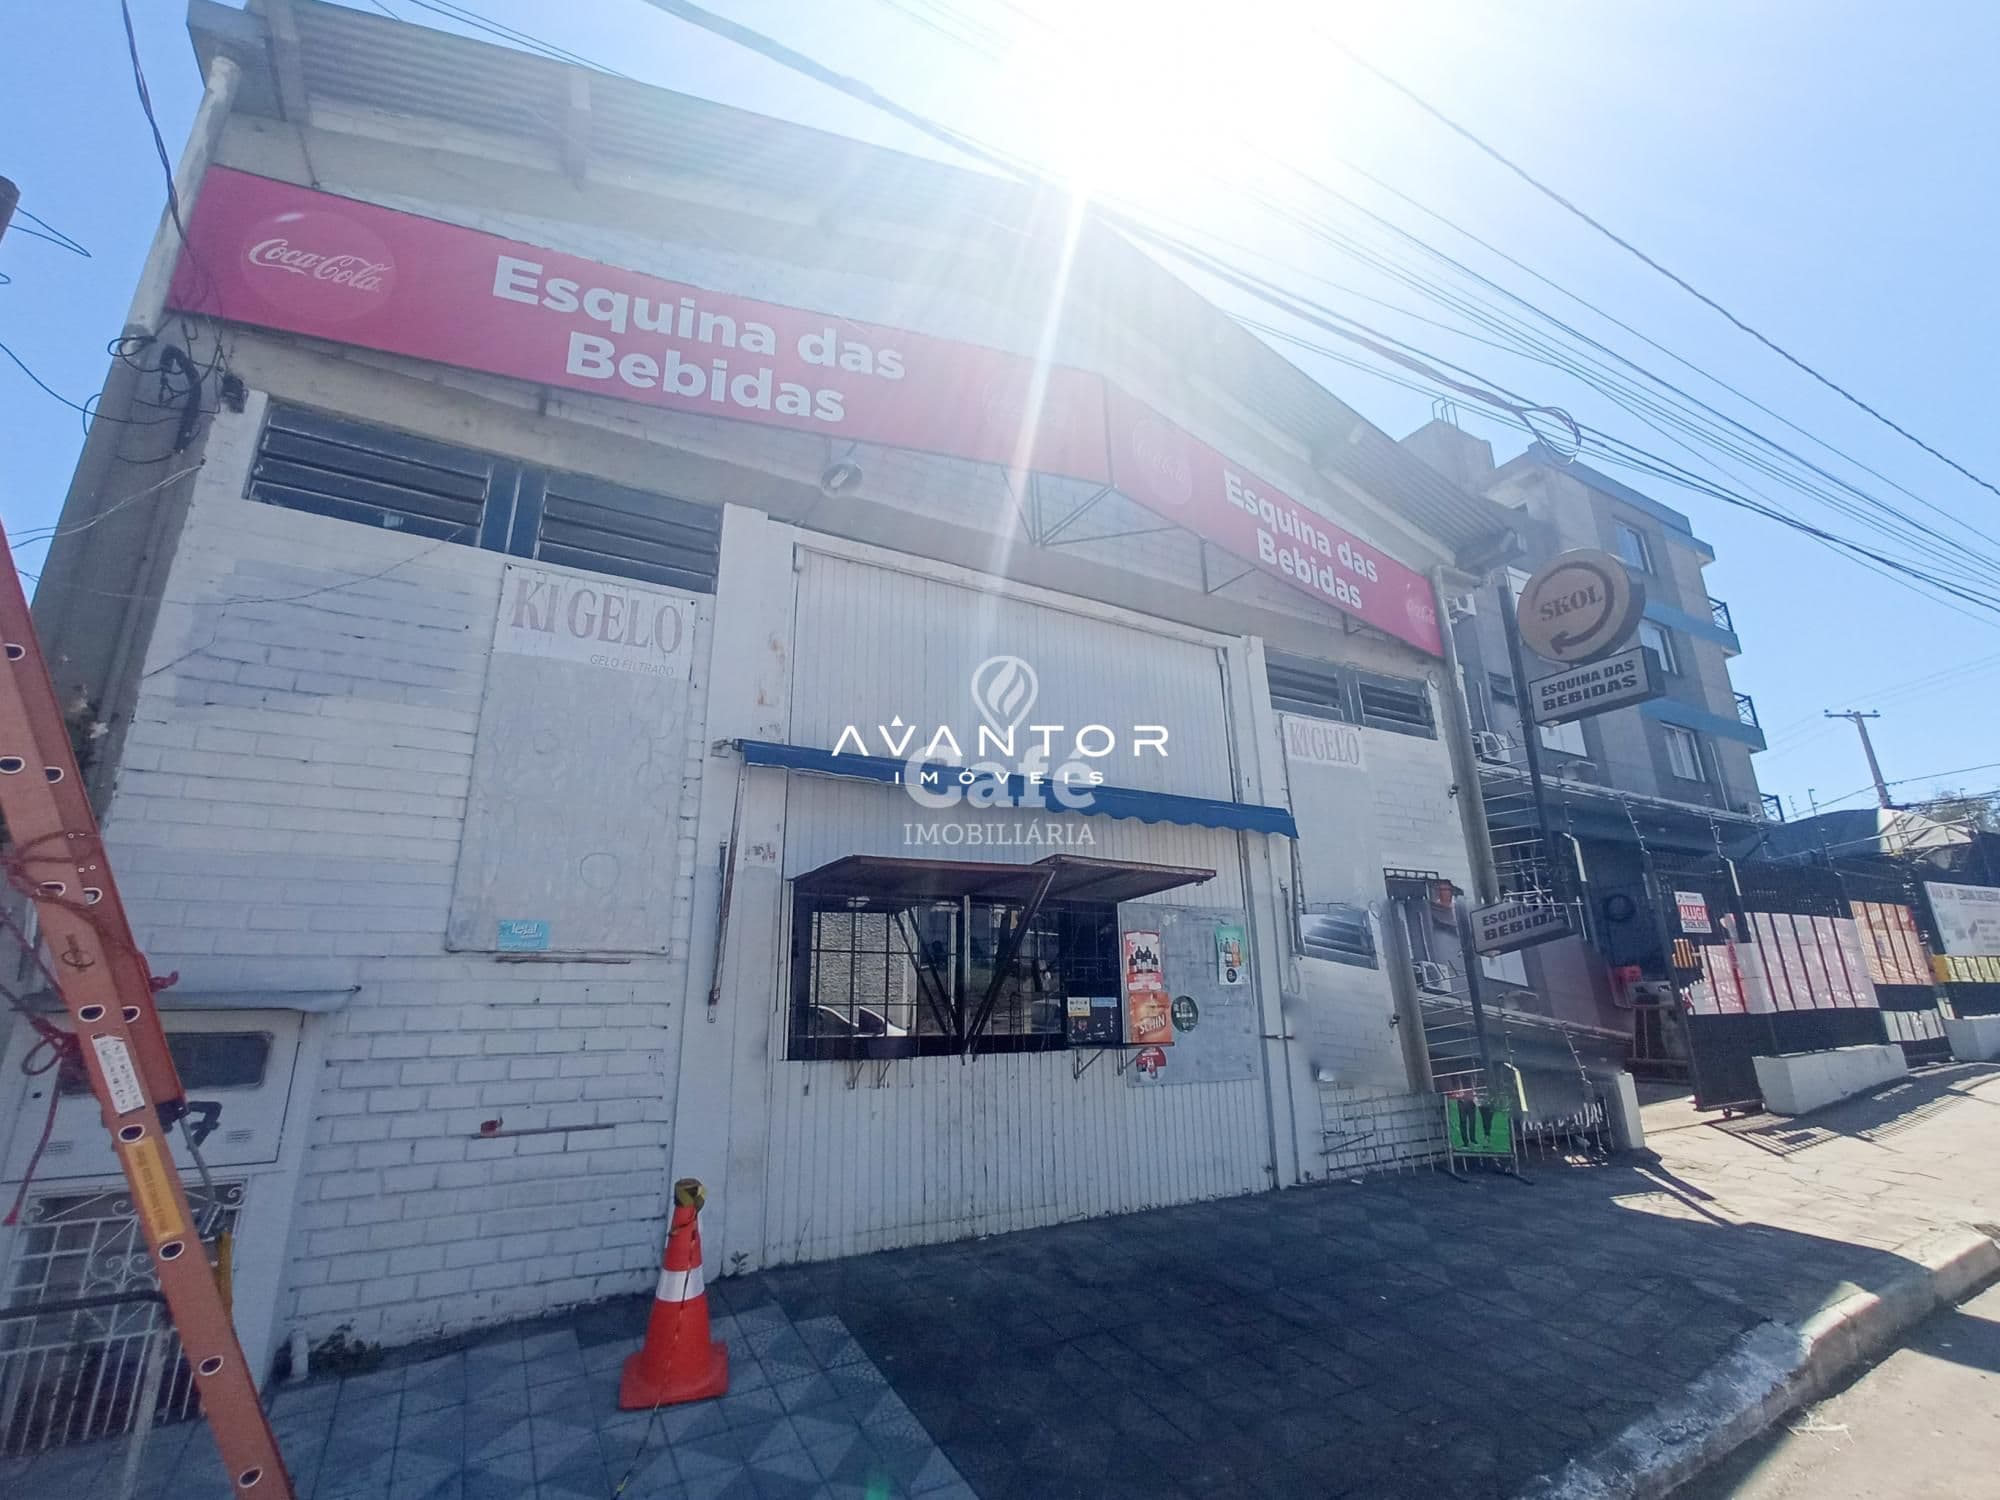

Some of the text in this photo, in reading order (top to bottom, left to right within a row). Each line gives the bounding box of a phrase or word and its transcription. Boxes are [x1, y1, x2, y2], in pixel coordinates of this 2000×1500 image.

[248, 238, 391, 292] Coca-Cola
[492, 254, 906, 380] Esquina das
[565, 331, 846, 422] Bebidas
[1223, 468, 1378, 582] Esquina das
[1256, 527, 1362, 609] Bebidas
[1539, 585, 1603, 622] SKOL
[1541, 660, 1635, 697] ESQUINA DAS
[1543, 675, 1638, 711] BEBIDAS
[1680, 905, 1708, 920] ALUGA
